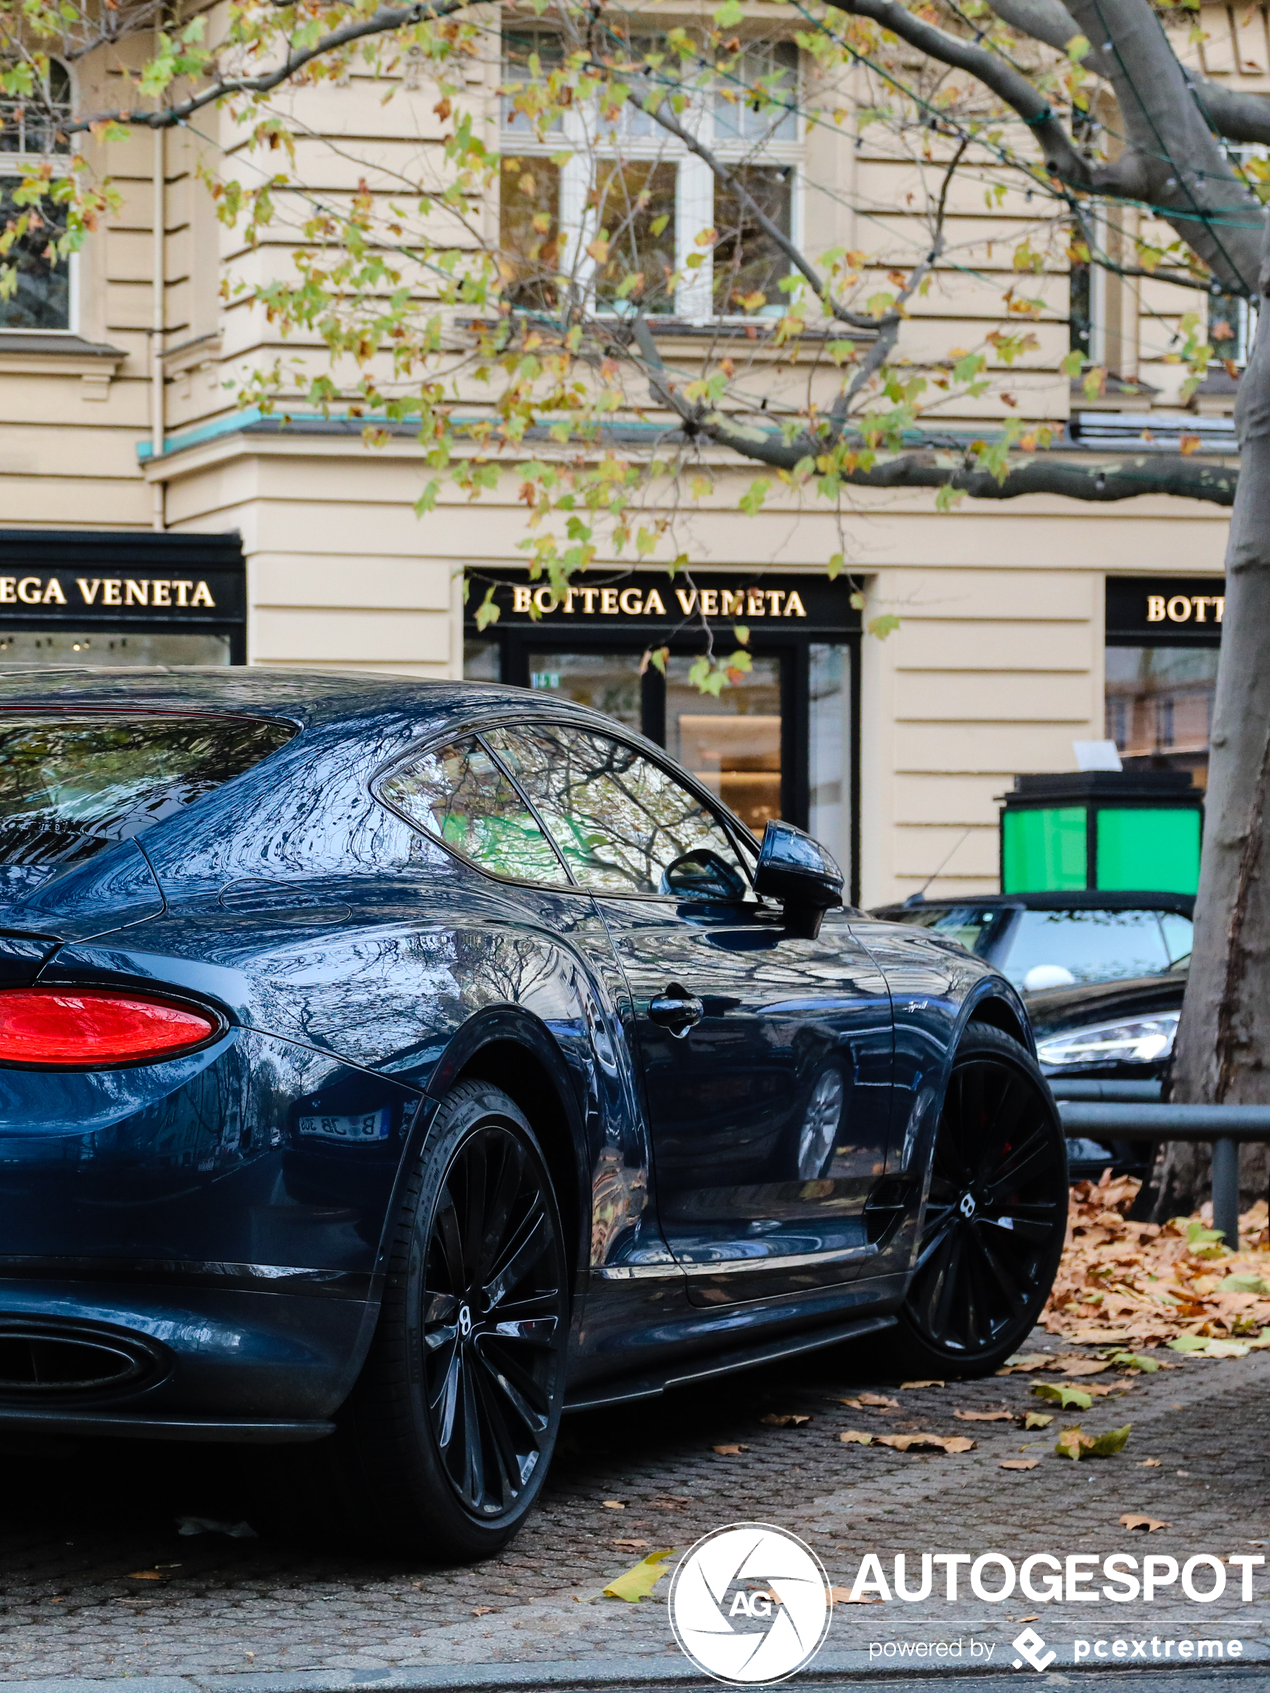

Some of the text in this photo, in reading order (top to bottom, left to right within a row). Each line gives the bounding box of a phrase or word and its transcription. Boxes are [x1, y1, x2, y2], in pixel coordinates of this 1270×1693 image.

[76, 578, 215, 607] VENETA
[512, 586, 807, 617] BOTTEGA VENETA
